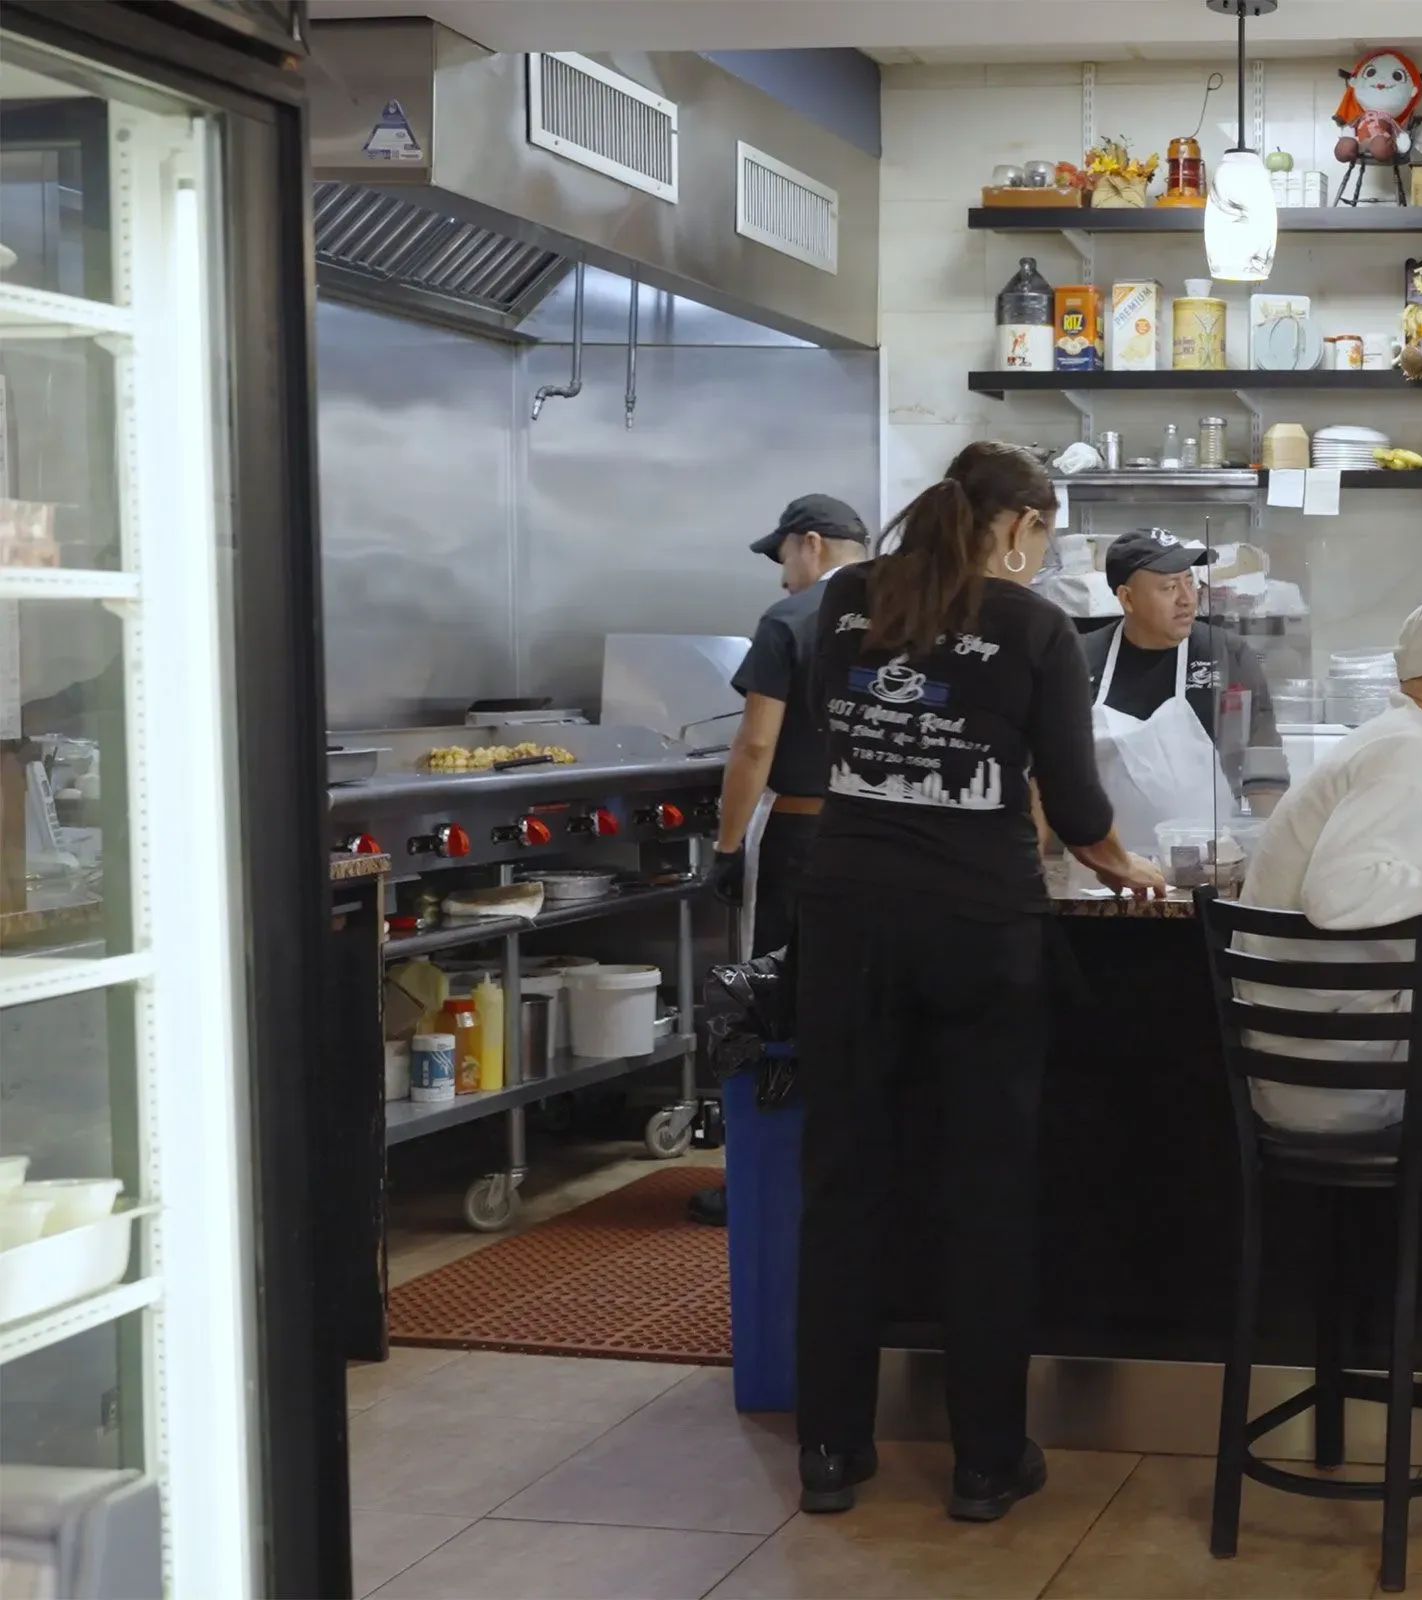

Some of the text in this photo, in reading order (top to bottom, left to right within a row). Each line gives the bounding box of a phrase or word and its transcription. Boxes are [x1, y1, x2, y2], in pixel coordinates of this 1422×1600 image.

[1114, 286, 1153, 327] PREMIUM
[1063, 313, 1083, 331] RITZ
[827, 698, 856, 717] 407
